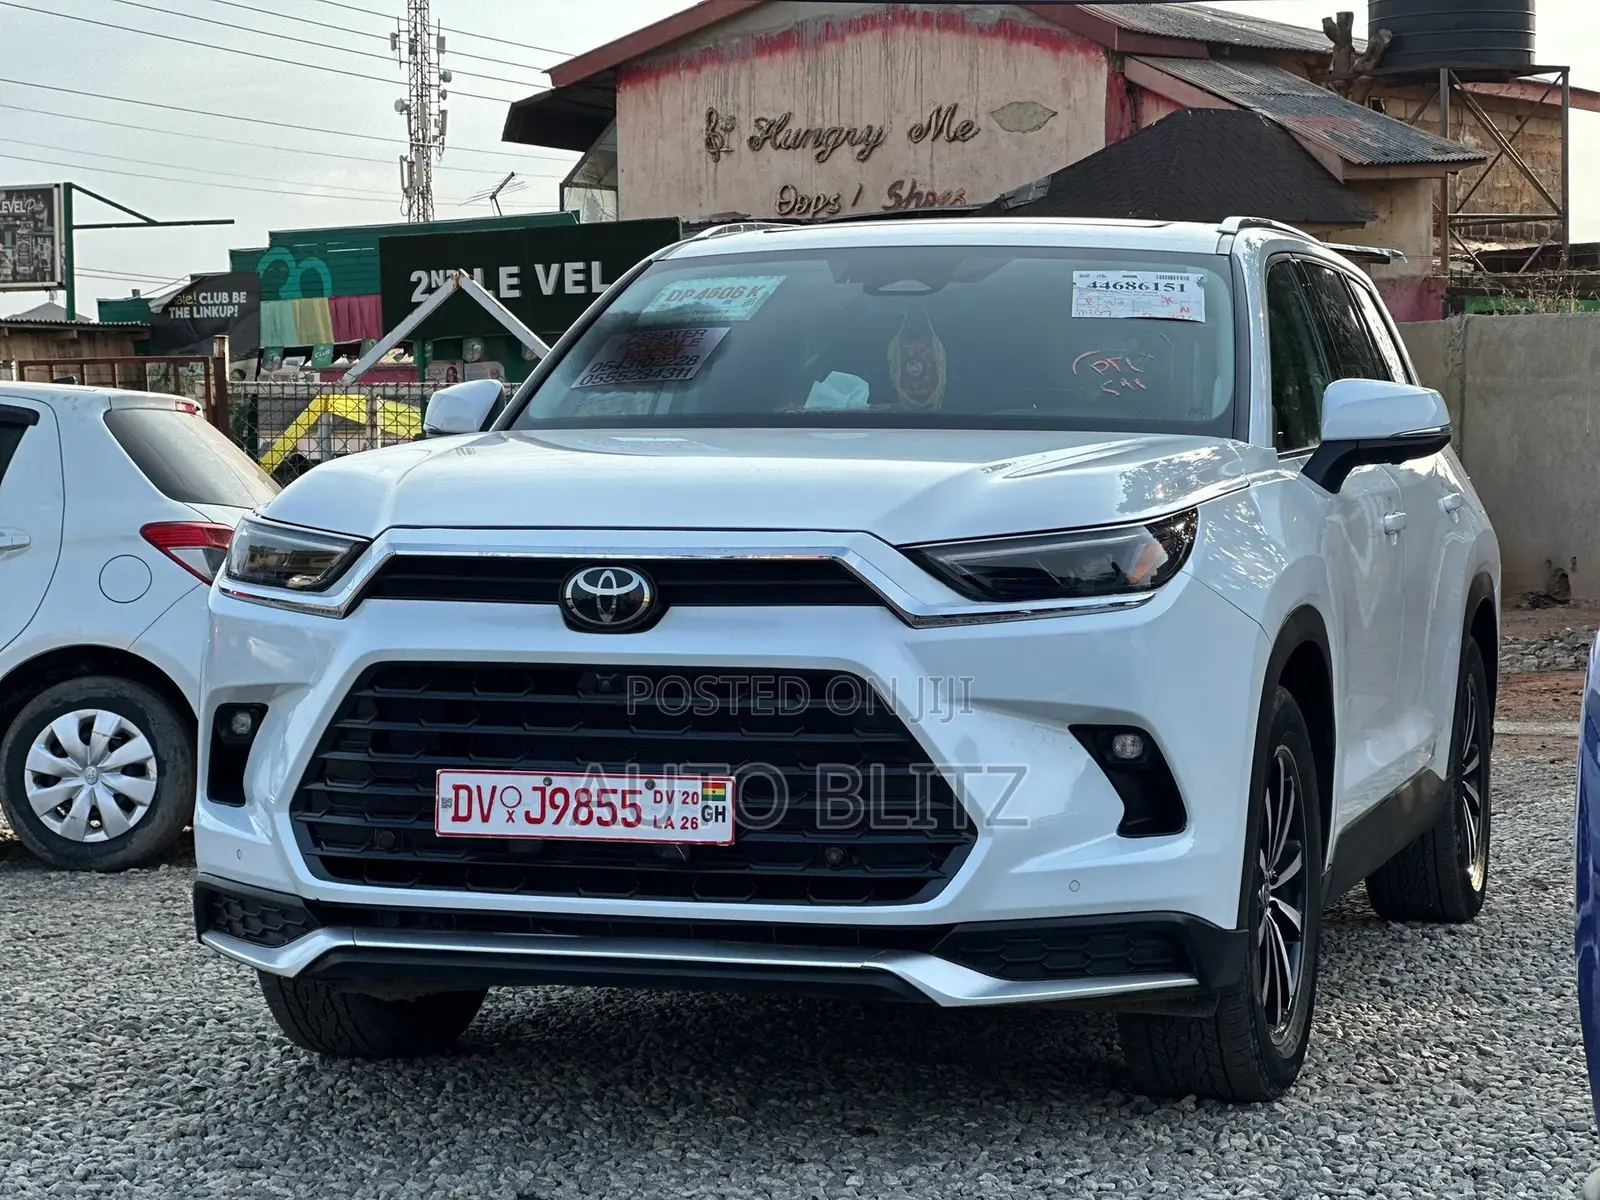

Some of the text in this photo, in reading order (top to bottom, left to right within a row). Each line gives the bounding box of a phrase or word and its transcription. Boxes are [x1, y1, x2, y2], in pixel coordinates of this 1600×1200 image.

[747, 102, 981, 163] Hungry Me
[1086, 281, 1186, 293] 44686151
[198, 291, 229, 305] CLUB
[231, 291, 247, 304] BE
[168, 305, 239, 319] THE LINKUP!
[451, 784, 498, 823] DV
[524, 786, 643, 828] J9855
[653, 790, 675, 805] DV
[700, 804, 727, 823] GH
[653, 814, 675, 830] LA
[679, 815, 699, 830] 26
